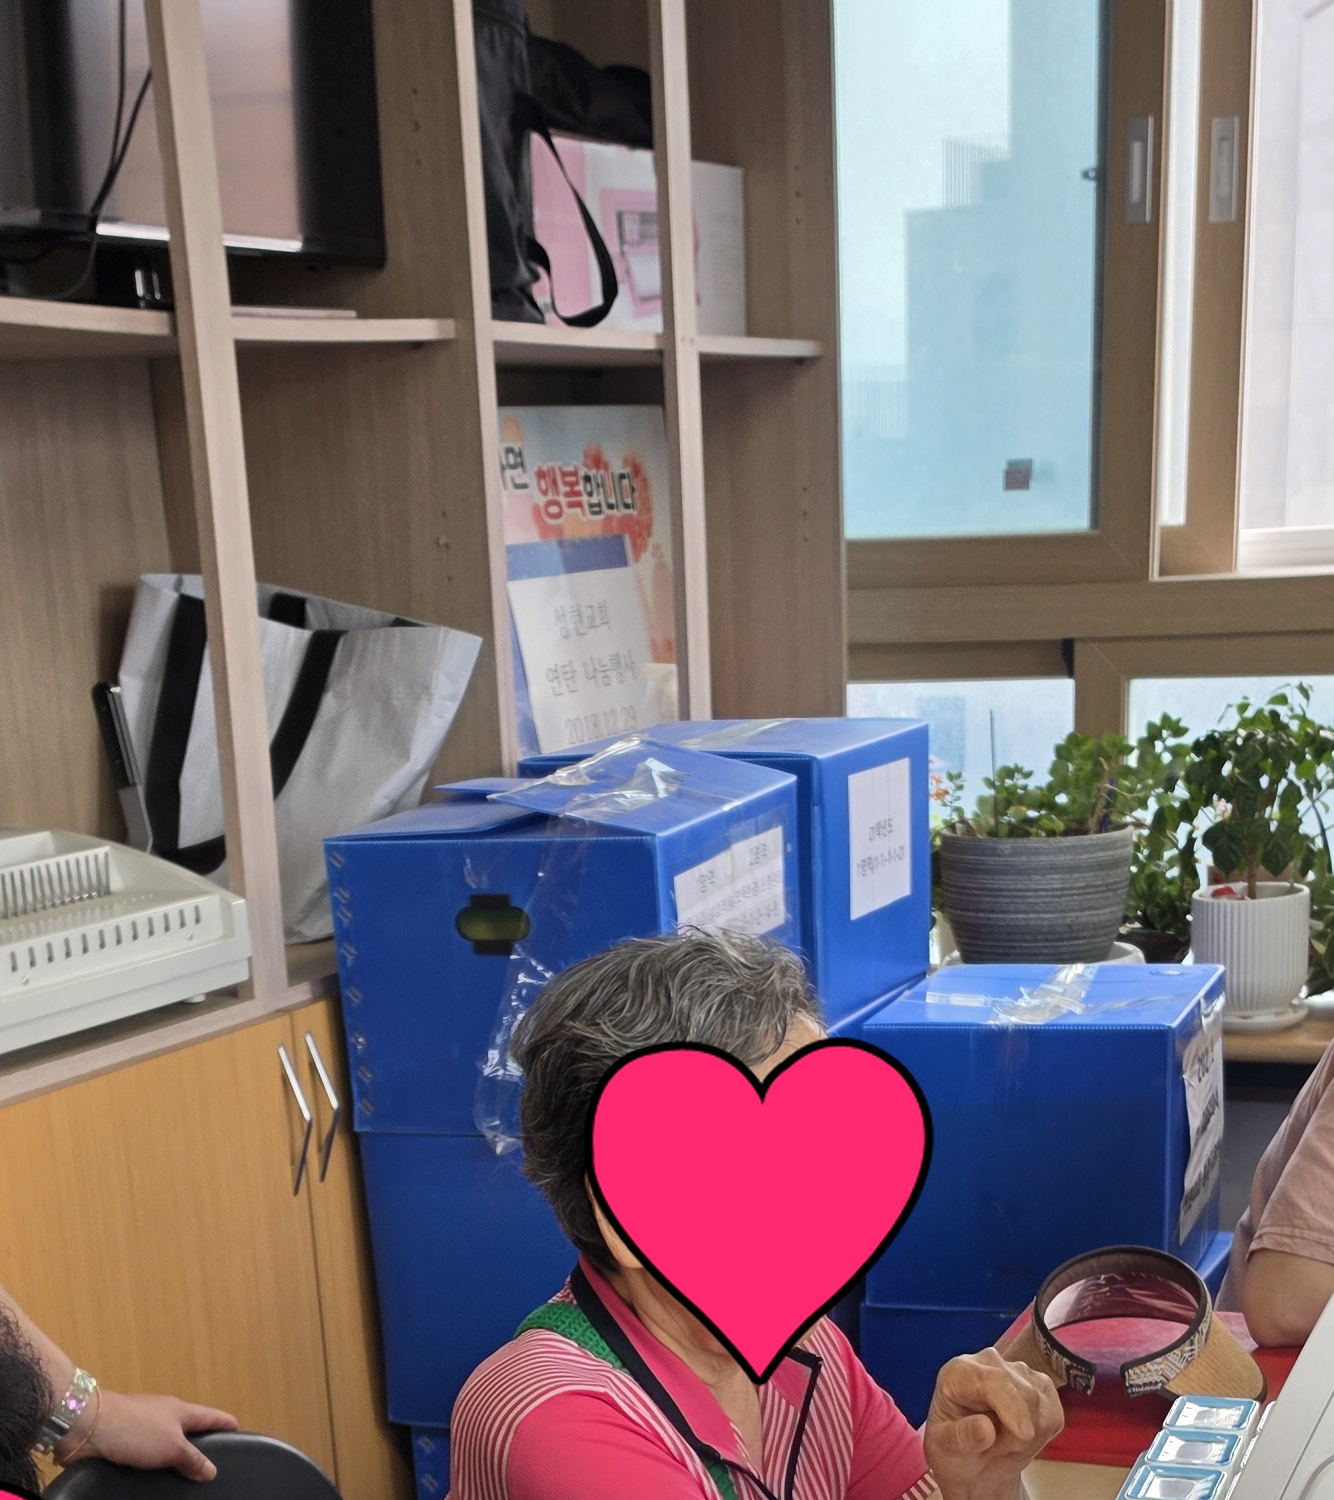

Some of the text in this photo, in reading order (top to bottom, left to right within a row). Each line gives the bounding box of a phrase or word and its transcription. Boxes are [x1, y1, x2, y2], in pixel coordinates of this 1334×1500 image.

[500, 446, 636, 520] 면 행복합니다
[546, 664, 579, 697] 연탄
